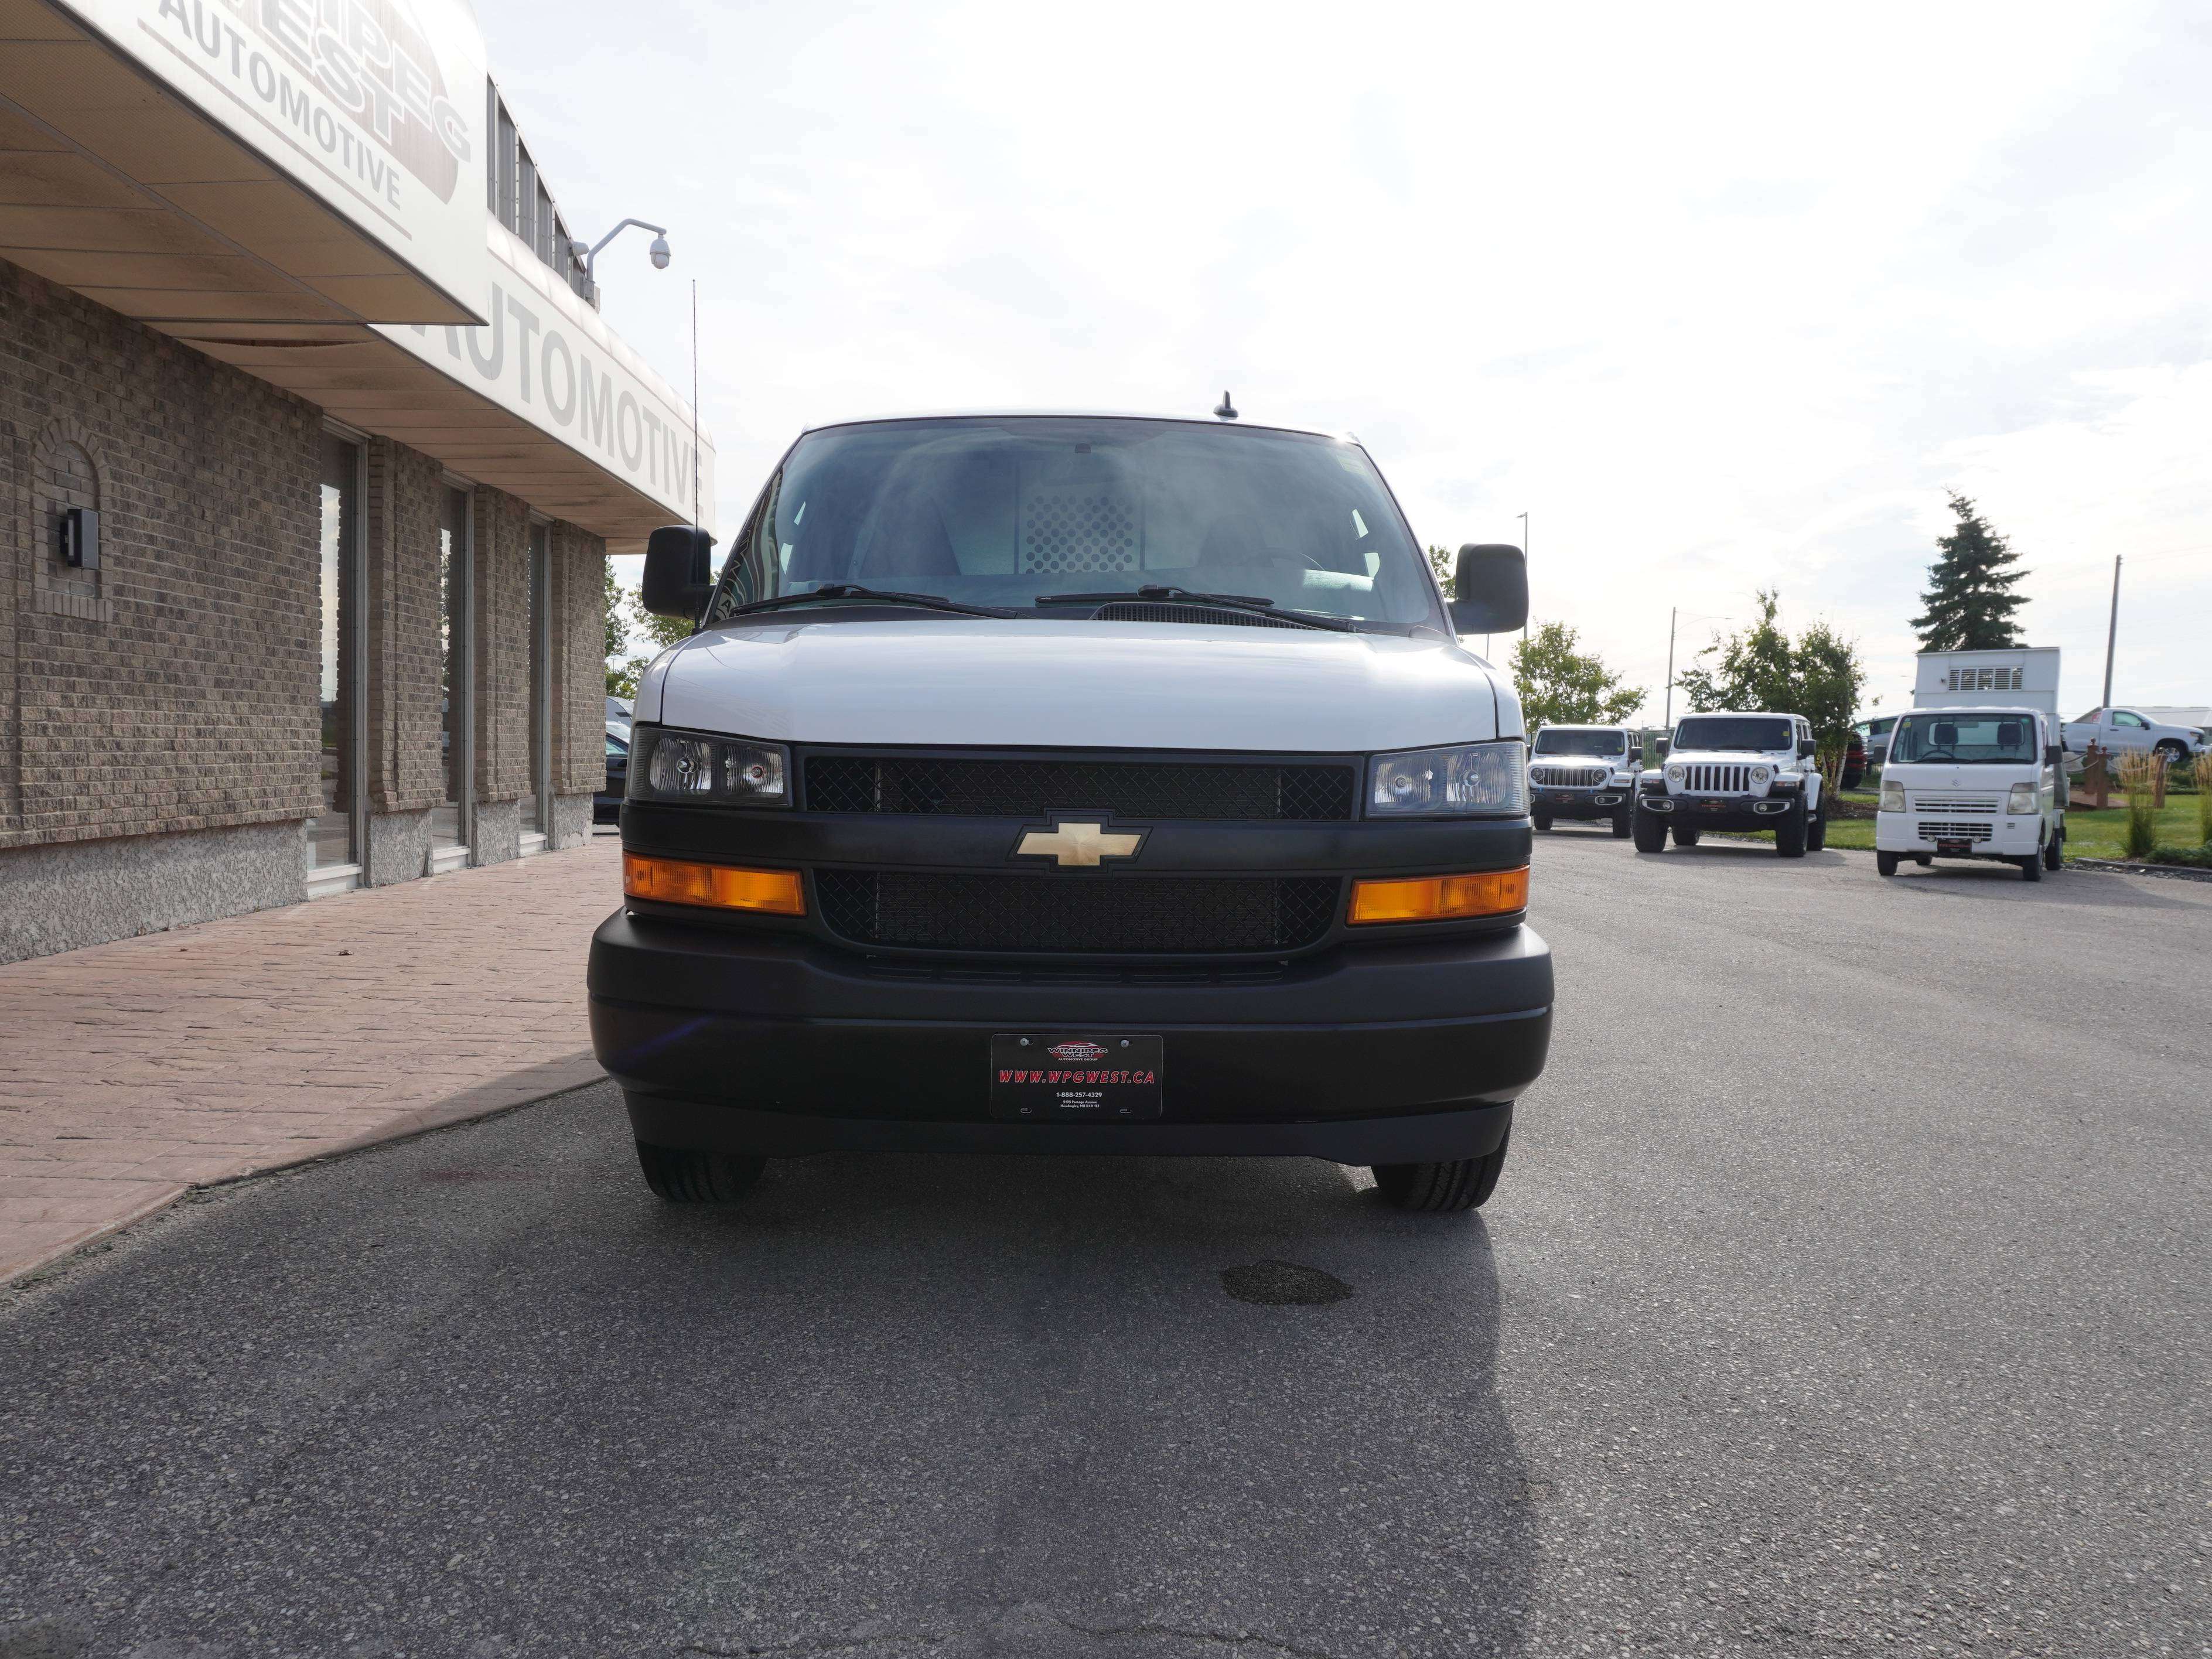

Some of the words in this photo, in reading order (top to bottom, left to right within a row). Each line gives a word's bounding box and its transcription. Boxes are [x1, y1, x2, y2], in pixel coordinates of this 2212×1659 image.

[159, 0, 401, 211] AUTOMOTIVE
[230, 0, 405, 145] EST
[998, 1070, 1155, 1084] WWW.WPGWEST.CA
